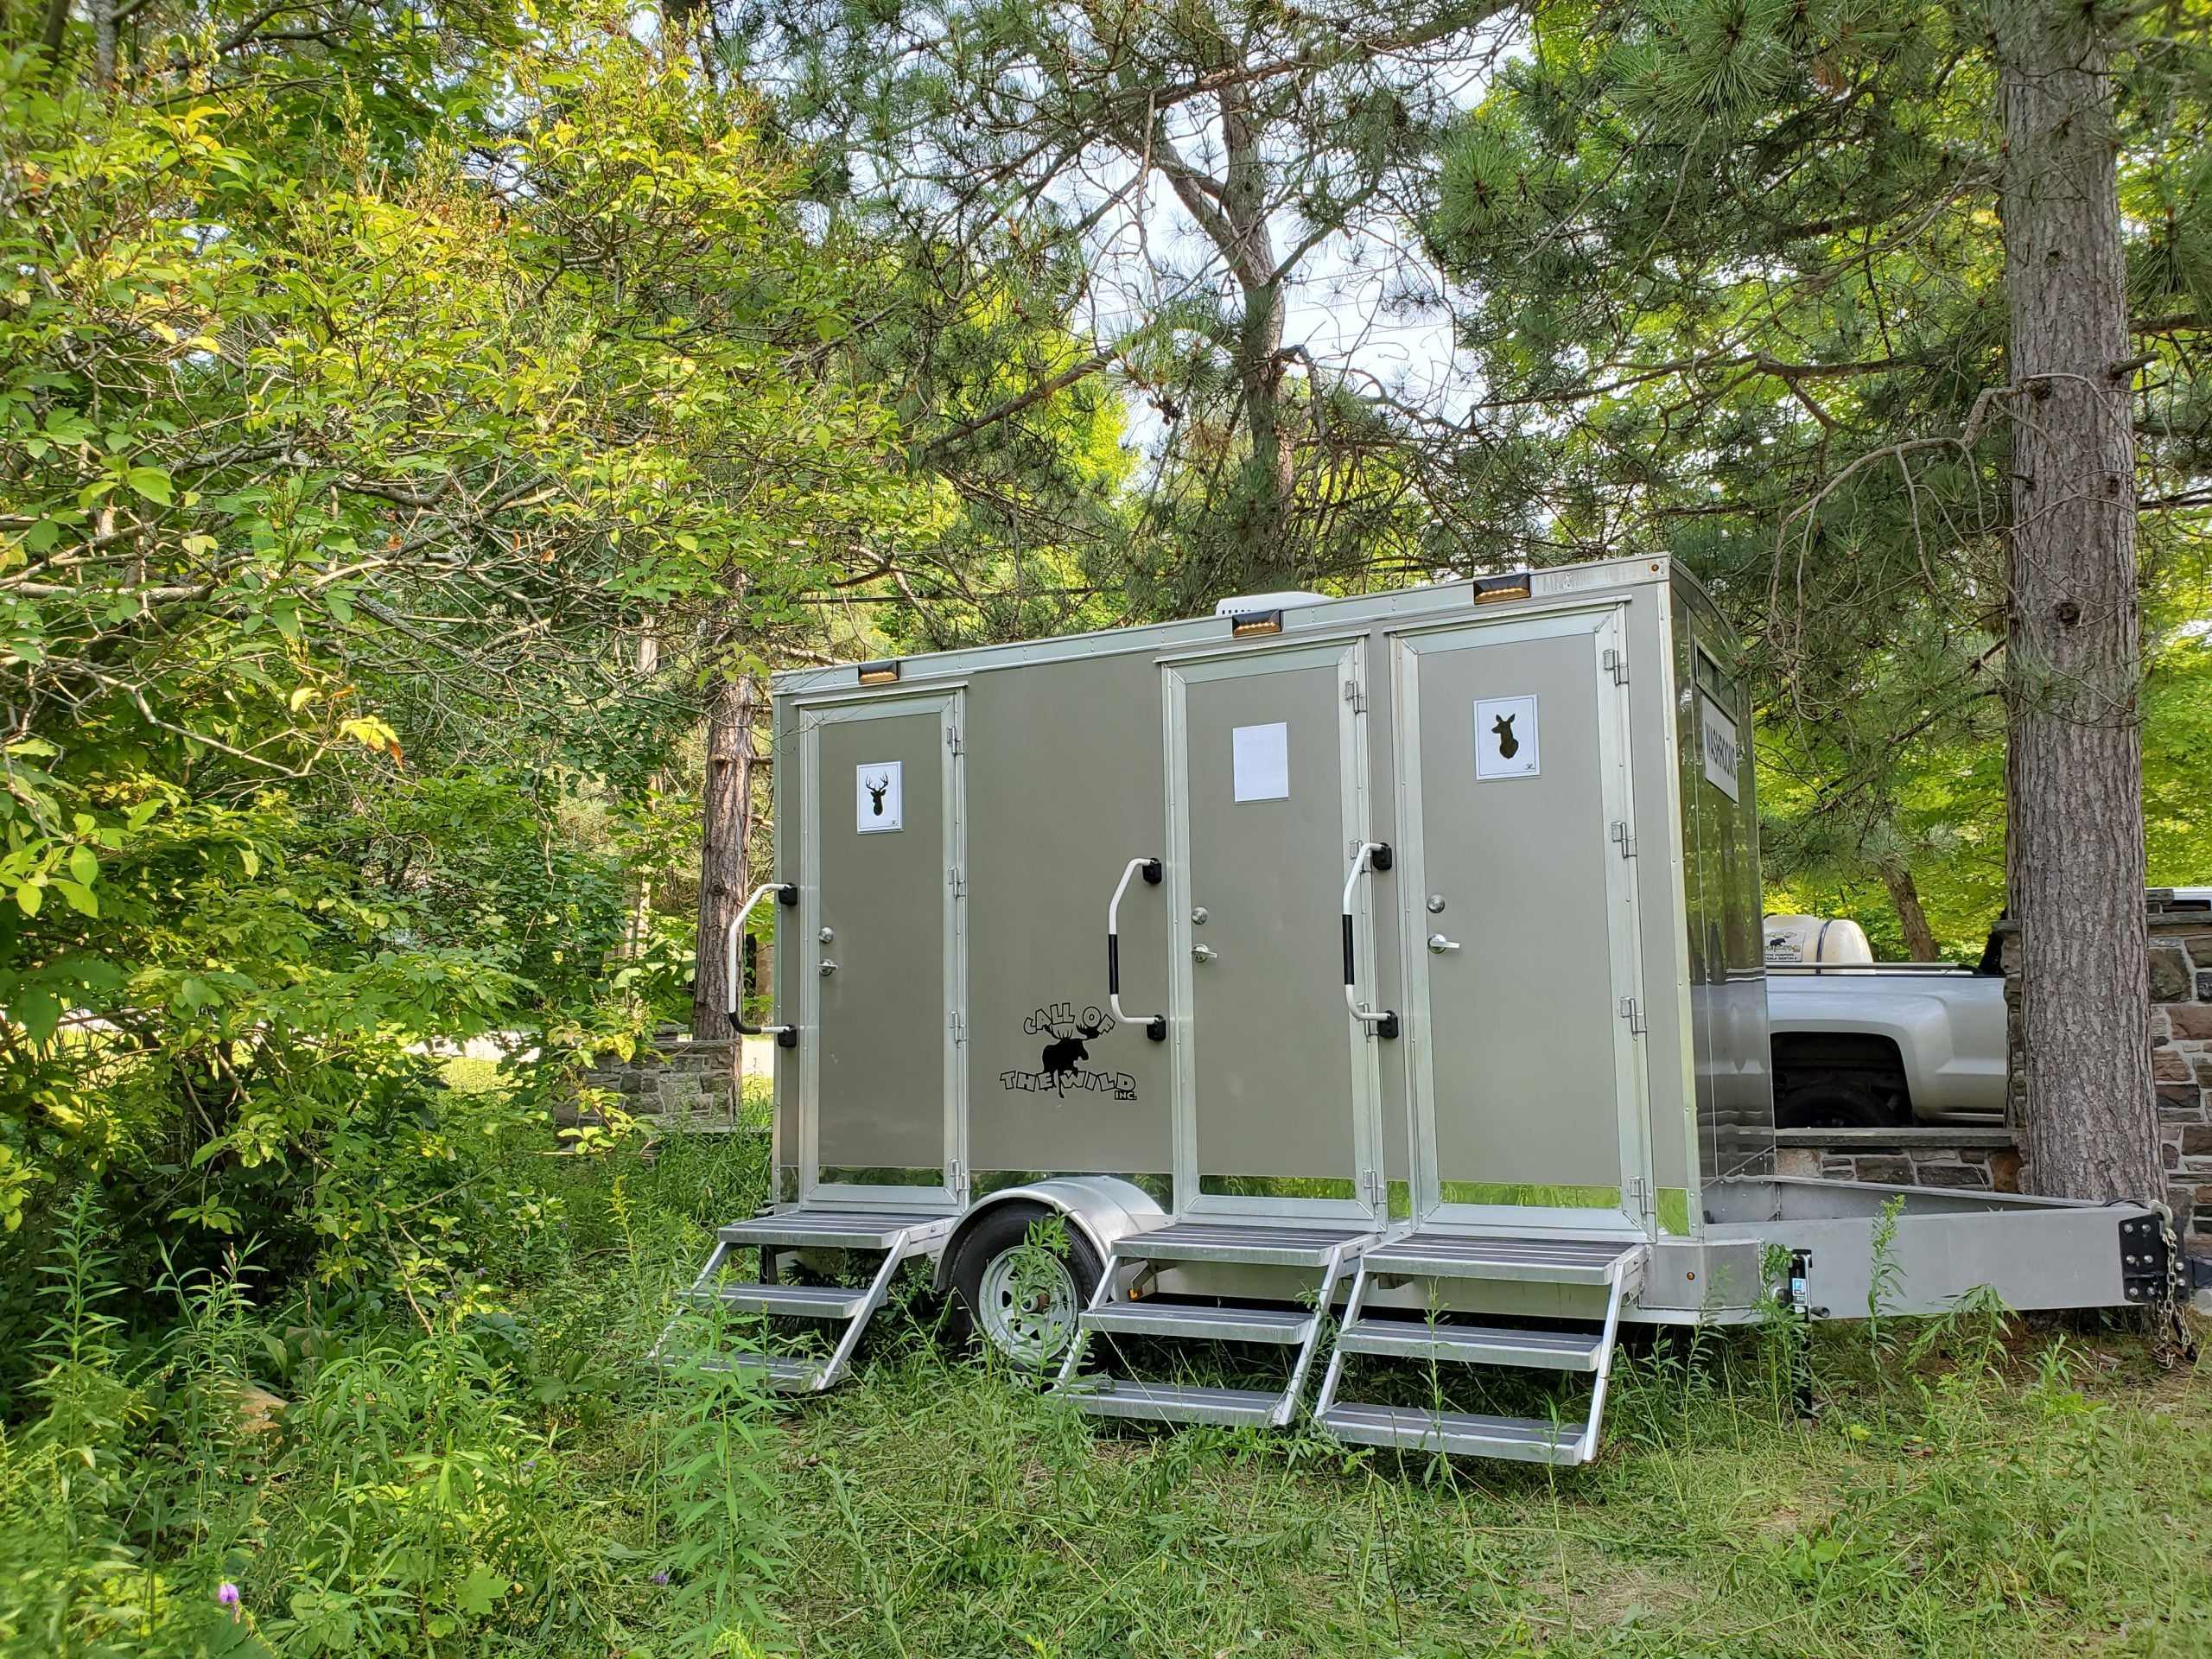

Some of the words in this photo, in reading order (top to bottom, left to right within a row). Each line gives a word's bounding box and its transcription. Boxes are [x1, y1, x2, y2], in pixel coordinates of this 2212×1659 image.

[1704, 720, 1737, 781] WASHROOMS
[1023, 1002, 1076, 1035] CALL
[1082, 1006, 1116, 1035] OF
[1000, 1070, 1055, 1092] THE
[1058, 1070, 1136, 1092] WILD
[1114, 1090, 1137, 1100] INC.
